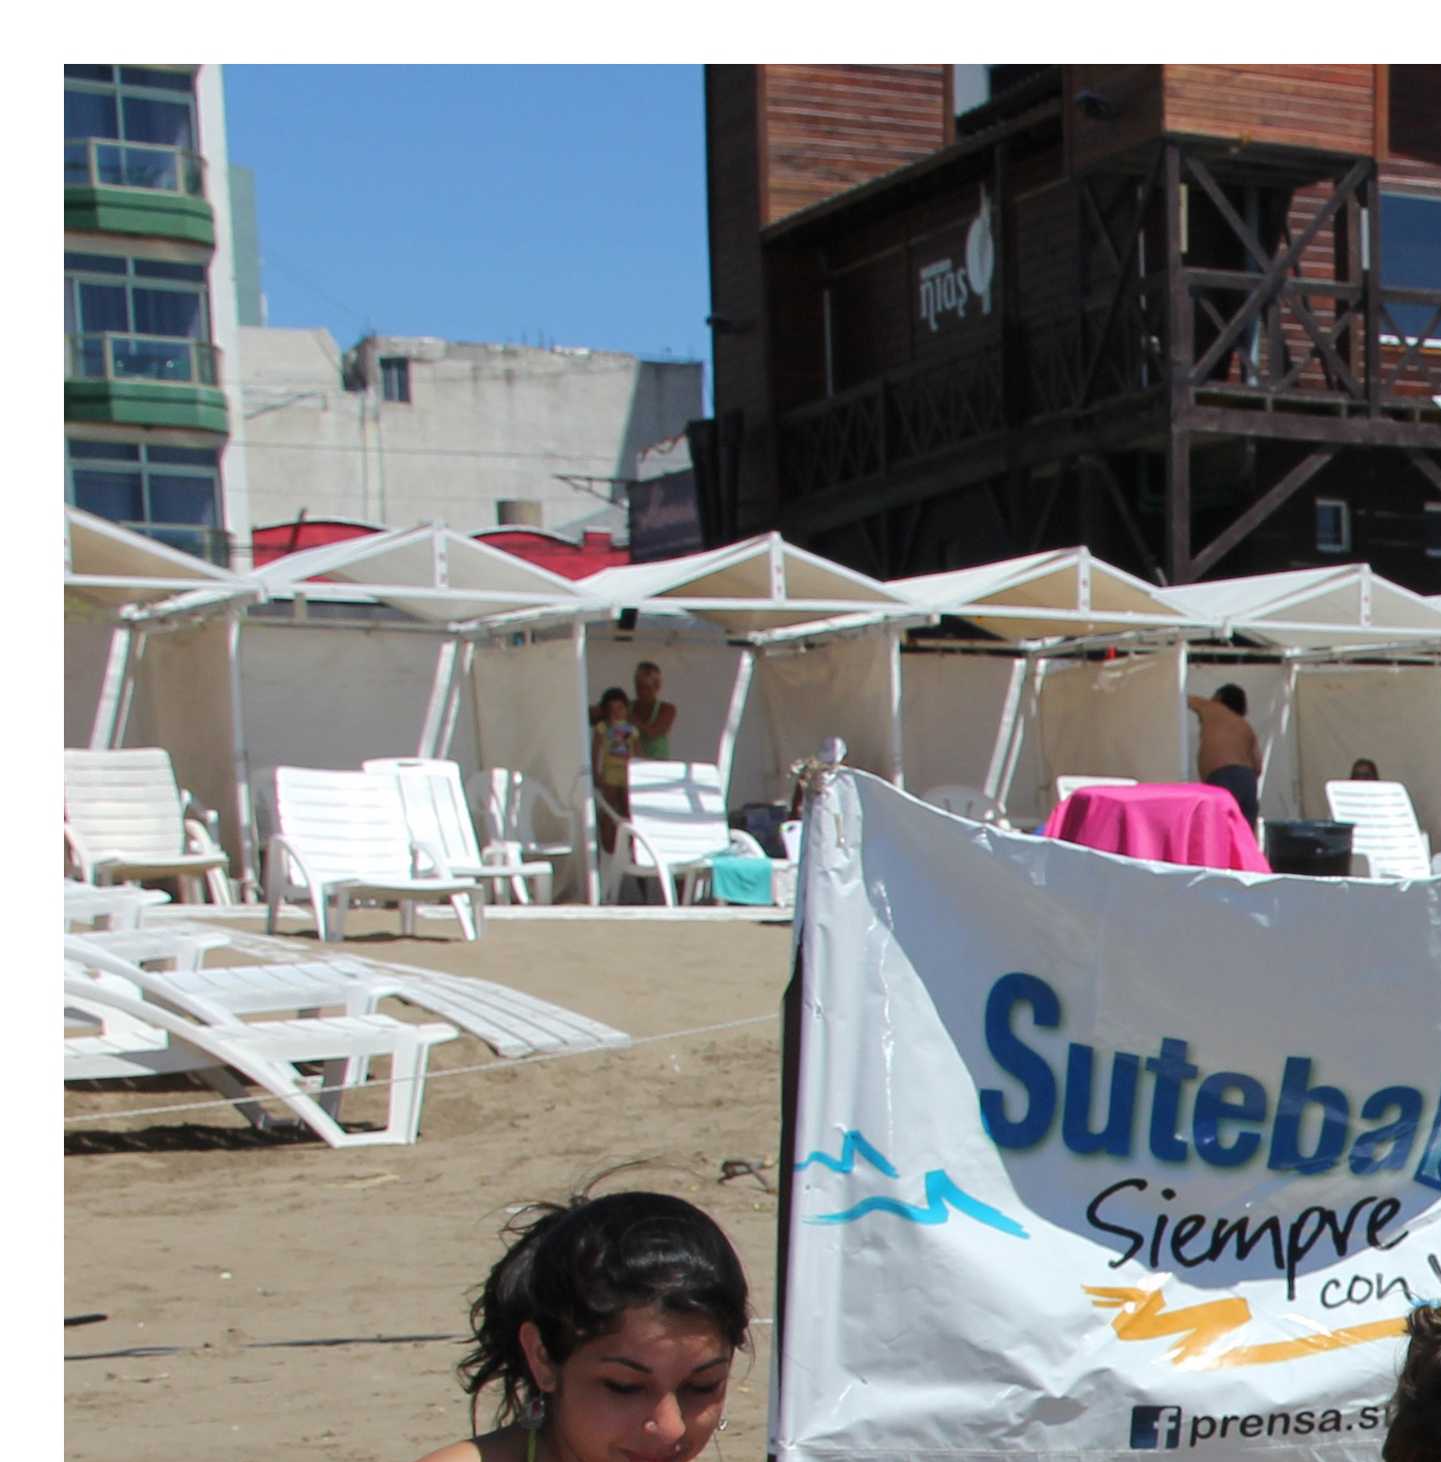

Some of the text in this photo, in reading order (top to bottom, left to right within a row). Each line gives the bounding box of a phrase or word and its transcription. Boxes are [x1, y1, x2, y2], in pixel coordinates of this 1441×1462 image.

[978, 972, 1426, 1177] Suteba
[1086, 1178, 1410, 1300] Siempre
[1319, 1272, 1414, 1309] con
